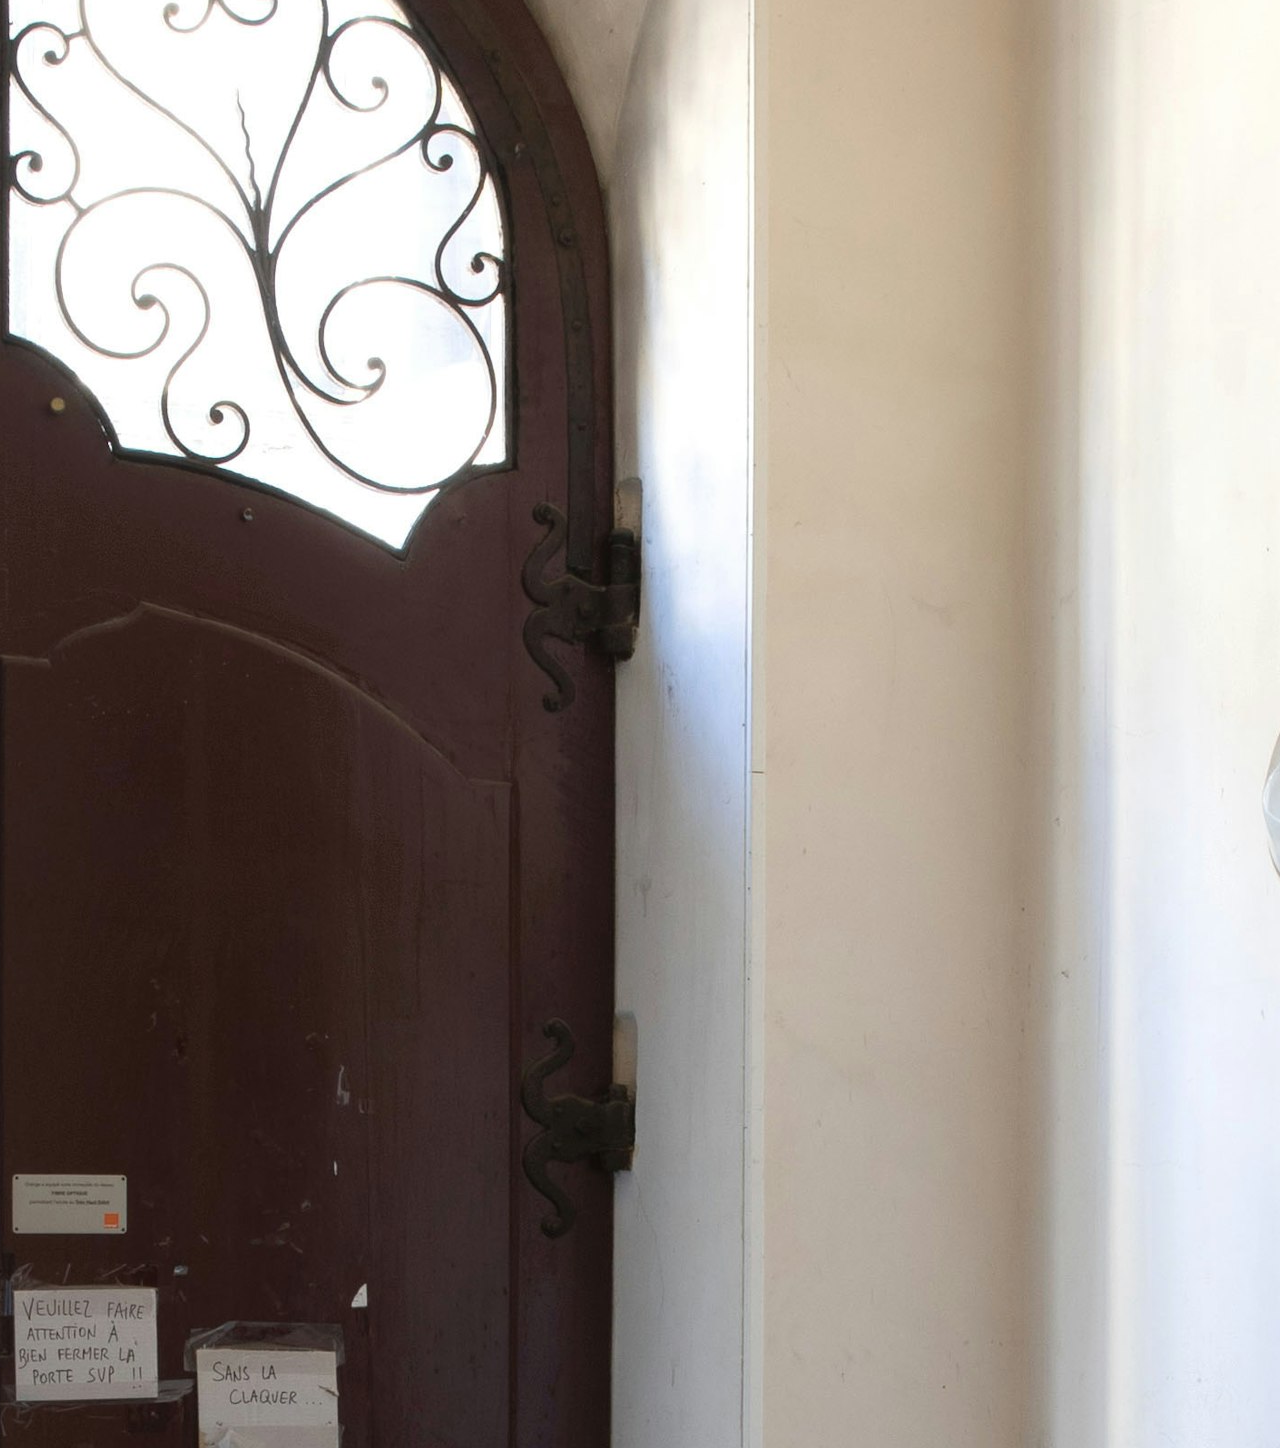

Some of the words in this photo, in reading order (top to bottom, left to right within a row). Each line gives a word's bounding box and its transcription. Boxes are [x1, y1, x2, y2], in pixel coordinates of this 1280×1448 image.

[57, 1347, 110, 1361] FERMER
[32, 1368, 74, 1386] PORTE
[87, 1365, 115, 1384] SVP
[212, 1360, 250, 1382] SANS
[261, 1364, 277, 1380] LA
[229, 1388, 298, 1406] CLAQUER
